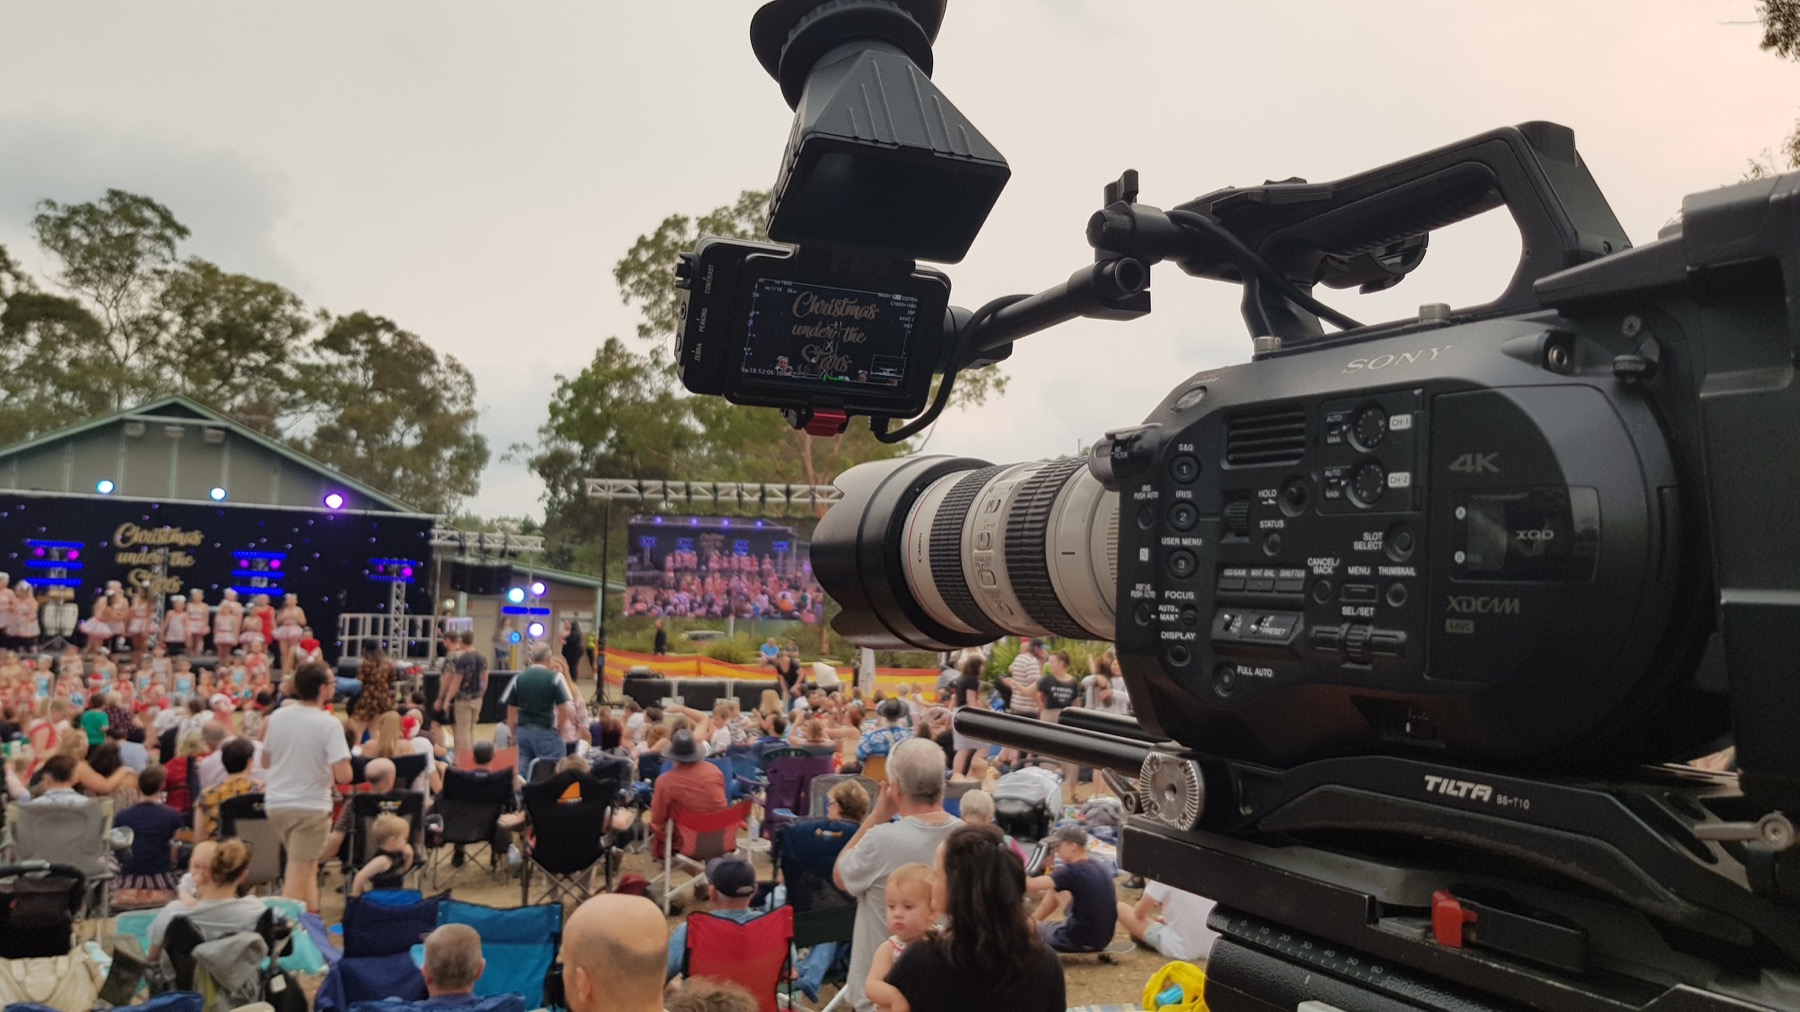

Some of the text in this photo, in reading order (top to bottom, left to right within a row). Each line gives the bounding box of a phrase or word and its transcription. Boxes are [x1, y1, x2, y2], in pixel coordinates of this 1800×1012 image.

[704, 264, 714, 294] CONTRAST
[792, 291, 879, 320] Christmas
[699, 308, 708, 332] PEAKING
[792, 320, 867, 343] under the
[694, 343, 703, 361] ZEBRA
[1342, 346, 1452, 374] SONY
[1326, 415, 1342, 423] AUTO
[1391, 418, 1409, 427] CH-1
[1178, 443, 1193, 451] S&Q
[1449, 452, 1500, 473] 4K
[1182, 466, 1187, 474] 1
[1325, 469, 1341, 477] AUTO
[1390, 475, 1408, 484] CH-2
[1146, 491, 1159, 499] AUTO
[1176, 490, 1192, 498] IRIS
[1258, 489, 1277, 498] HOLD
[1325, 490, 1339, 498] MAN
[1180, 512, 1187, 521] 2
[1259, 520, 1284, 528] STATUS
[113, 522, 205, 548] Christmas
[1363, 532, 1383, 541] SLOT
[1515, 529, 1554, 540] XQD
[1161, 537, 1202, 546] USER MENU
[1353, 541, 1383, 550] SELECT
[1178, 560, 1185, 569] 3
[1307, 557, 1340, 567] CANCEL/
[1263, 569, 1275, 577] BAL
[1279, 569, 1306, 577] SHUTTER
[1313, 566, 1333, 574] BACK
[1348, 567, 1371, 575] MENU
[1378, 567, 1416, 576] THUMBNAIL
[1131, 590, 1143, 598] PUSH
[1165, 591, 1194, 599] FOCUS
[1446, 595, 1520, 615] XDCAM
[1341, 606, 1375, 616] SEL/SET
[1161, 631, 1196, 640] DISPLAY
[1261, 628, 1287, 636] PRESET
[1237, 665, 1273, 677] FULL AUTO
[1424, 774, 1493, 802] TILTA
[1240, 919, 1384, 974] 0 10 20 30 40 50 60
